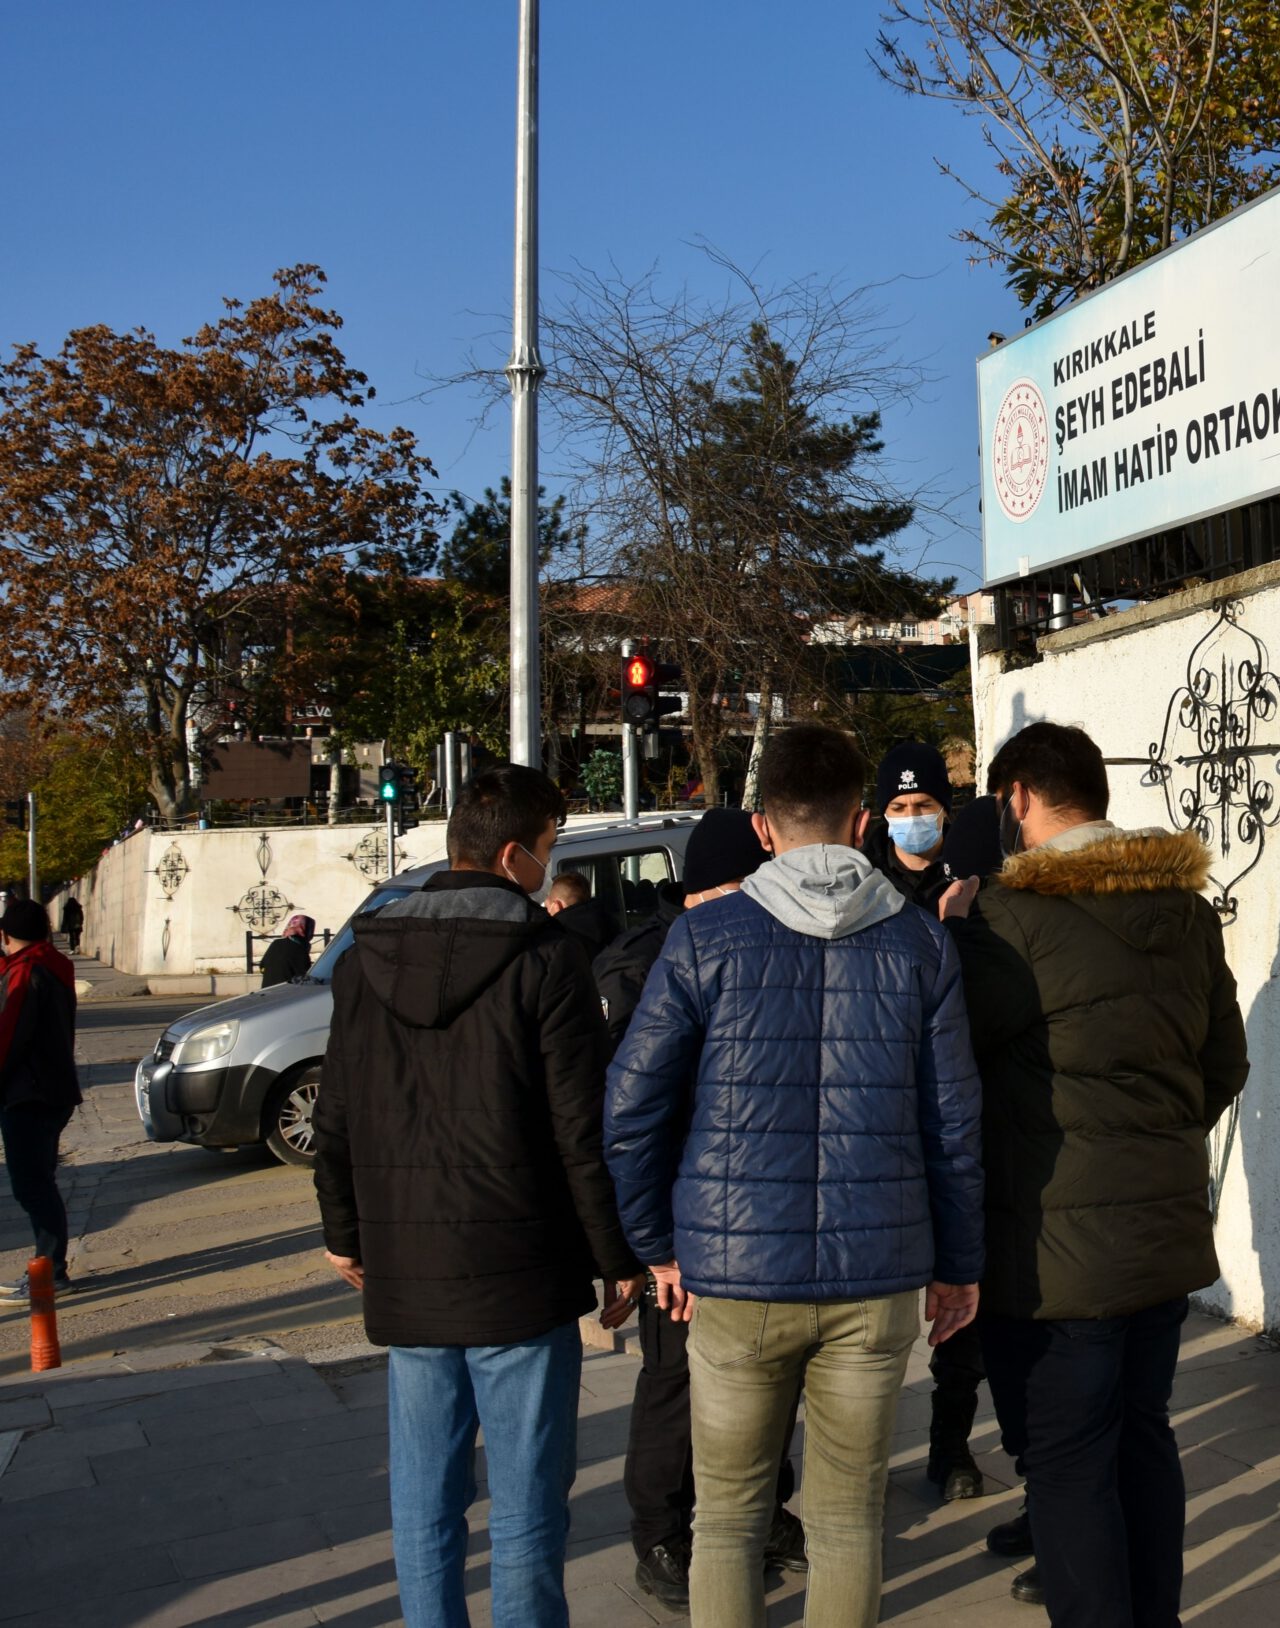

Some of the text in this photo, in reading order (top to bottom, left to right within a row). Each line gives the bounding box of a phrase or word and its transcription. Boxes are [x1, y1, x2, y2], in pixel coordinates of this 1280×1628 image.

[1053, 310, 1156, 387] KIRIKKALE
[1055, 328, 1206, 456] ŞEYH EDEBALİ
[1056, 456, 1109, 514] İMAM
[1114, 422, 1178, 492] HATİP
[898, 782, 918, 790] POLİS
